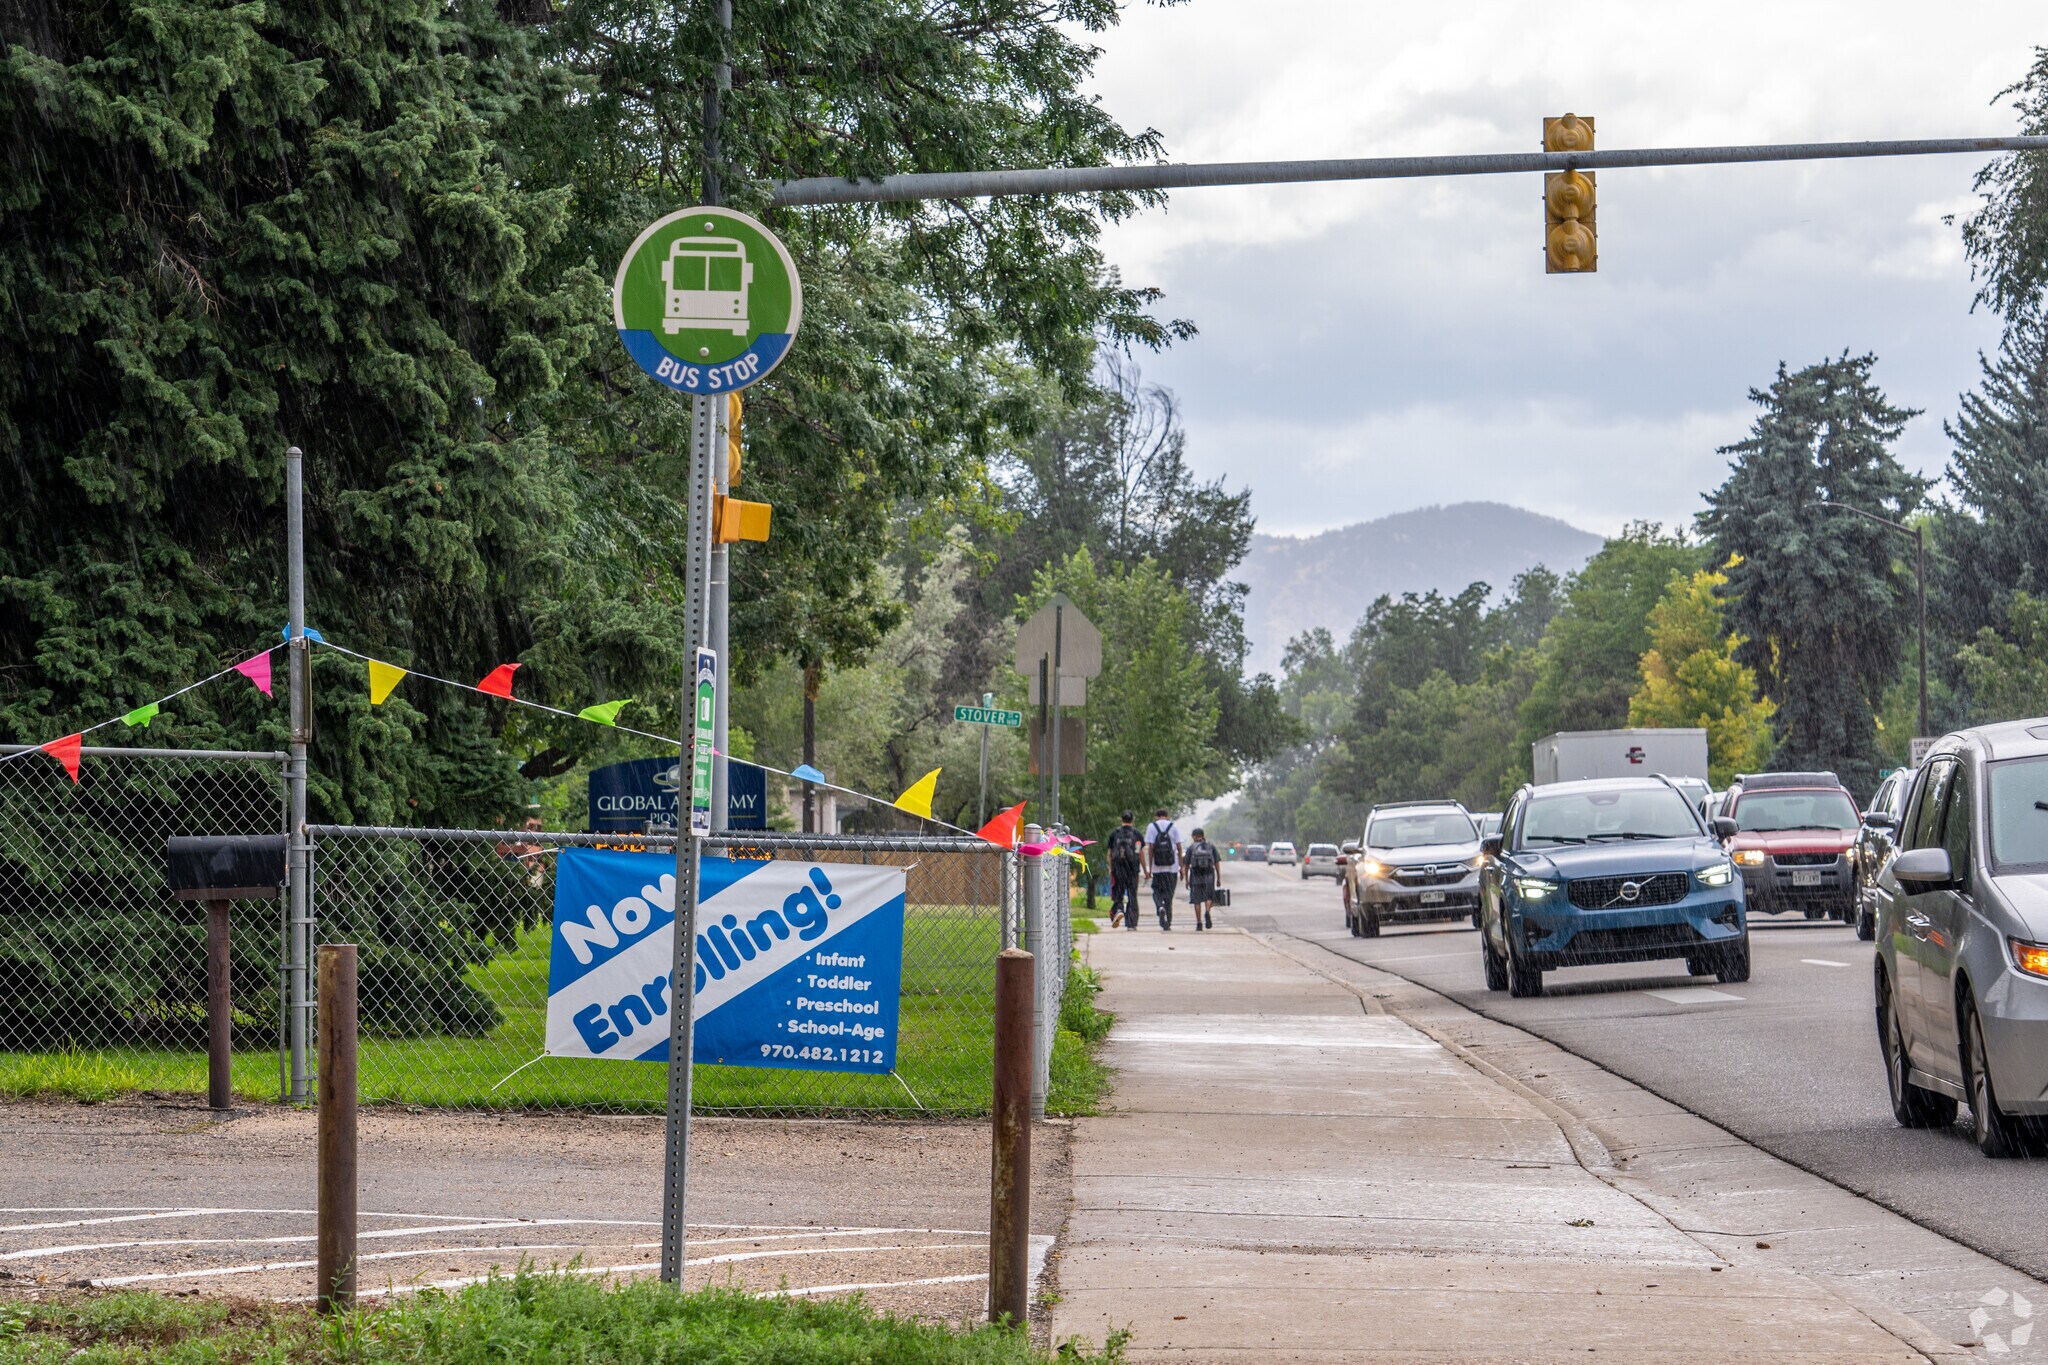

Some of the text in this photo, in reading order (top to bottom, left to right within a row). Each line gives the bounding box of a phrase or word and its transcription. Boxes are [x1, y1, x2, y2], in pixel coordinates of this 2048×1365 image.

[655, 353, 759, 389] BUS STOP
[960, 708, 1006, 724] STOVER
[597, 795, 666, 811] GLOBAL
[816, 952, 866, 968] Infant
[807, 974, 872, 991] Toddler
[796, 997, 879, 1014] Preschool
[787, 1019, 885, 1041] School-Age
[760, 1043, 884, 1064] 970.482.1212
